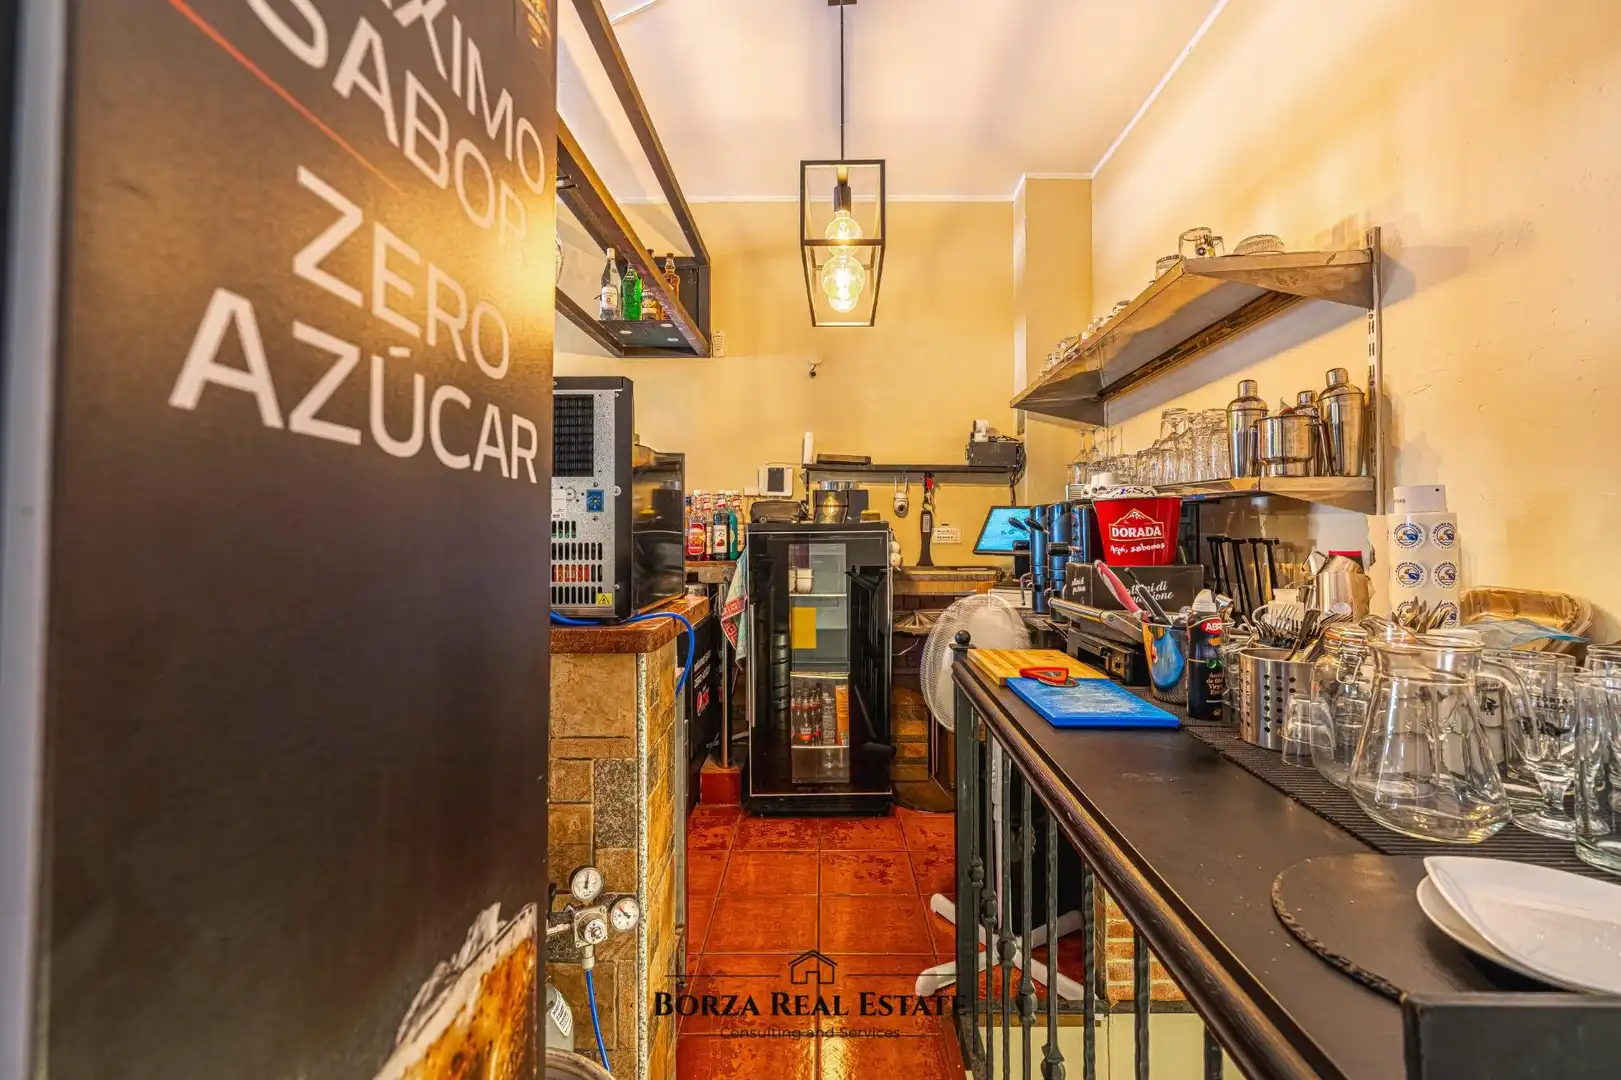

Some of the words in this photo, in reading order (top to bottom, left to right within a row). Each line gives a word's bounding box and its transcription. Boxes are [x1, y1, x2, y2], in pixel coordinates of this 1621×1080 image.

[293, 164, 510, 380] ZERO
[167, 287, 538, 485] AZÚCAR
[1111, 525, 1162, 538] DORADA
[1130, 541, 1166, 554] sabemos
[1156, 580, 1168, 592] di
